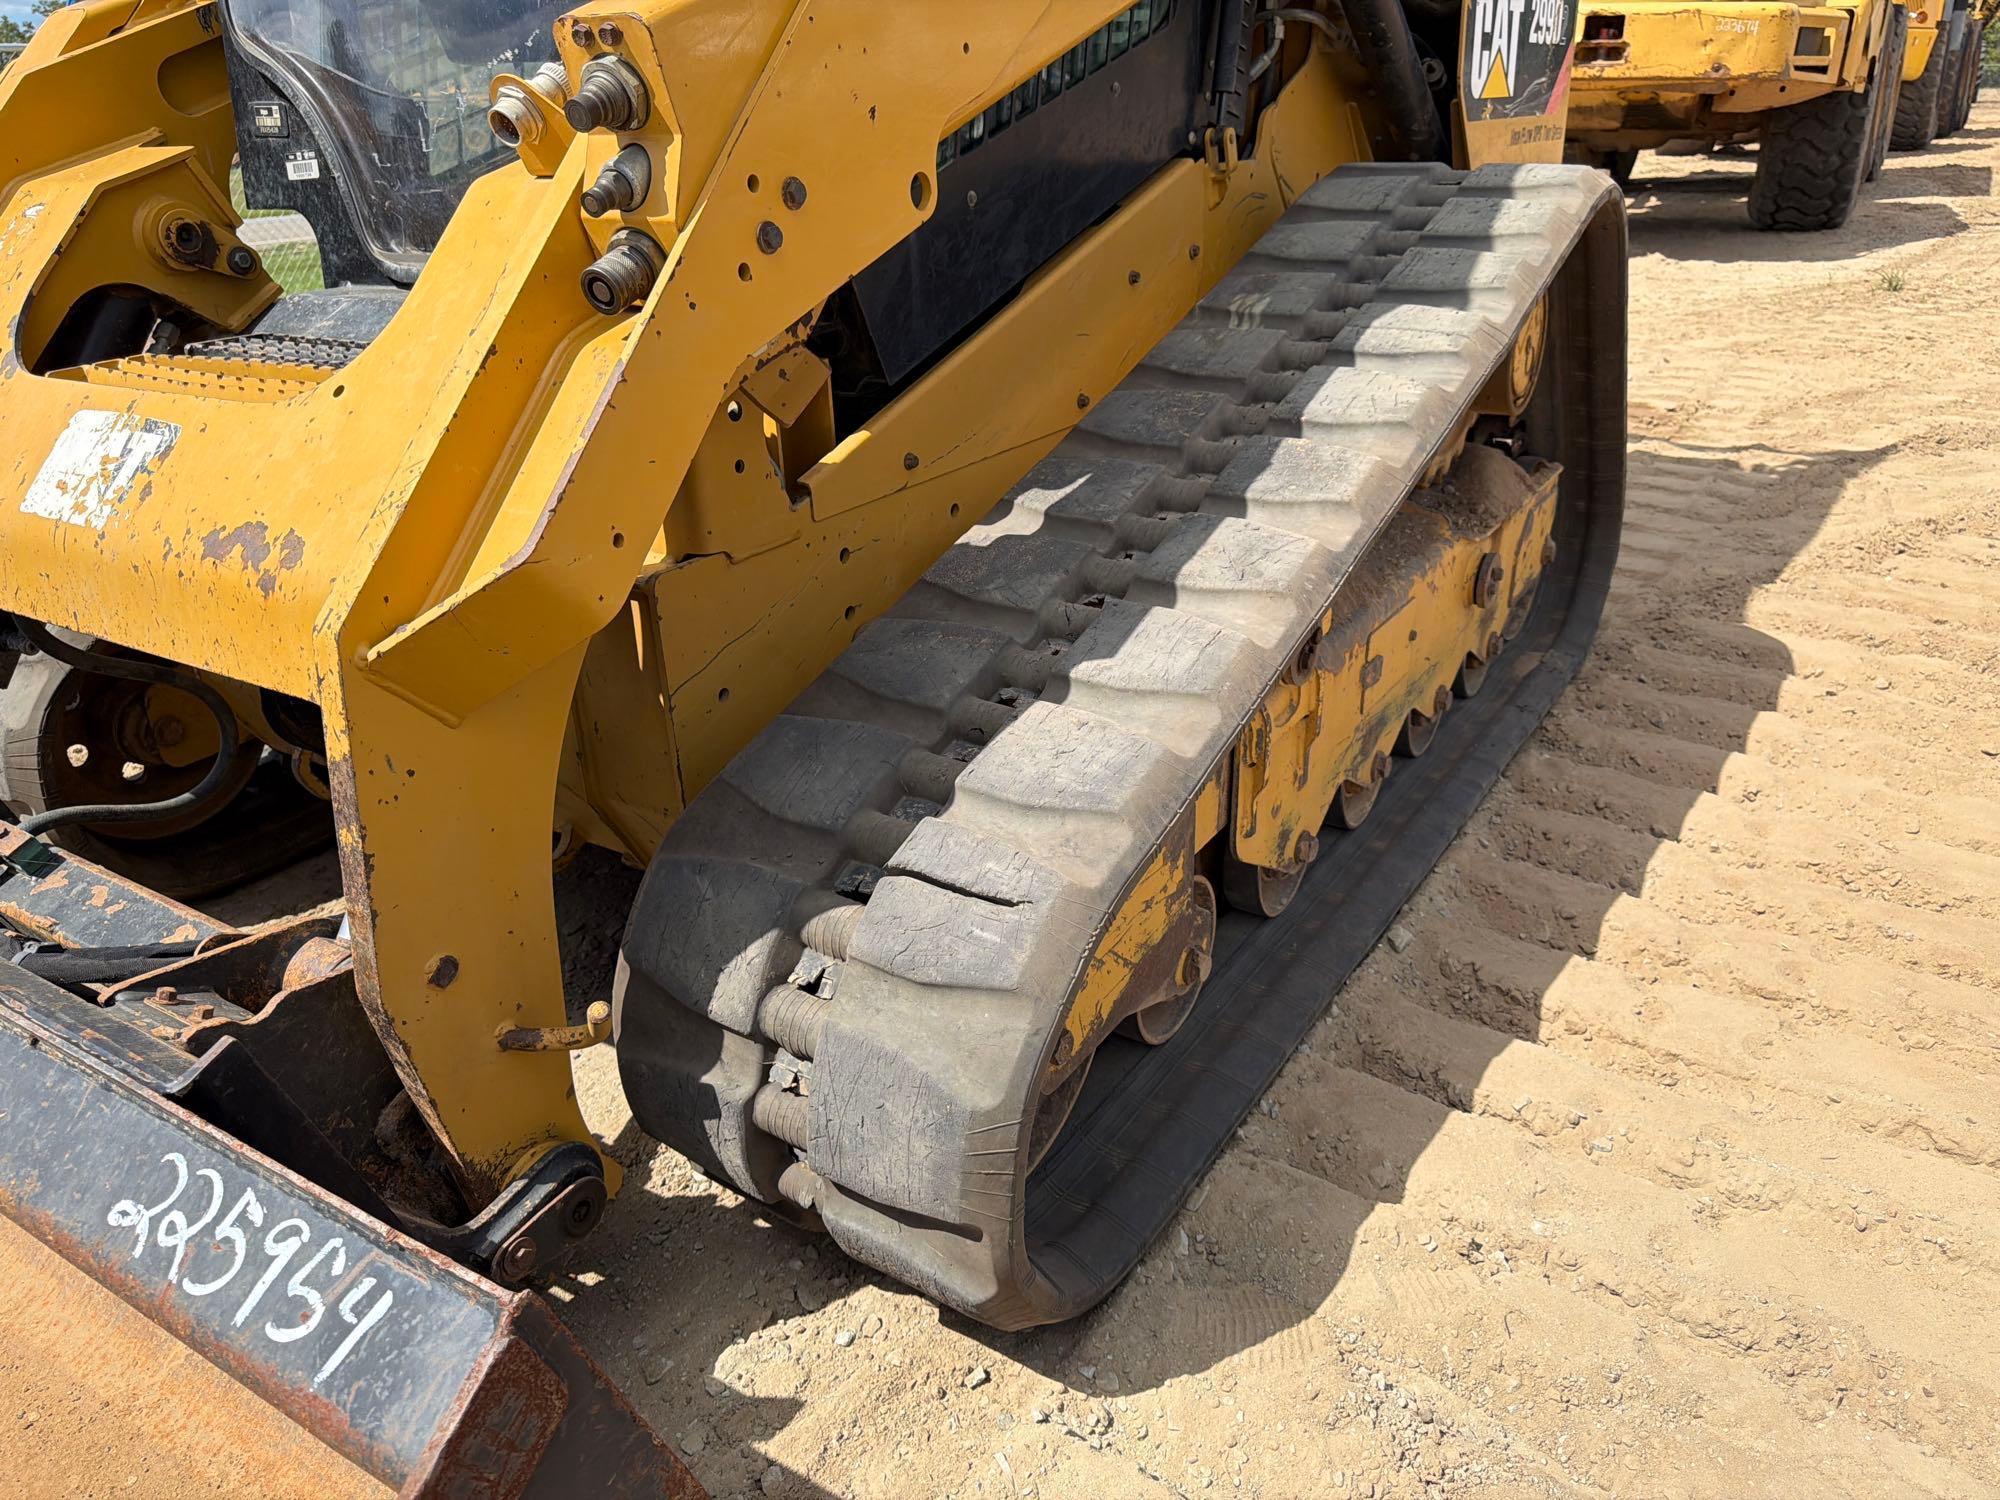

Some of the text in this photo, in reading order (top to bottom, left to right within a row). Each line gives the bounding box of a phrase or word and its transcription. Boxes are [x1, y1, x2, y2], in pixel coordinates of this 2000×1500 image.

[1470, 0, 1525, 99] CAT
[1715, 16, 1760, 36] 223674
[107, 1152, 394, 1392] 225954
